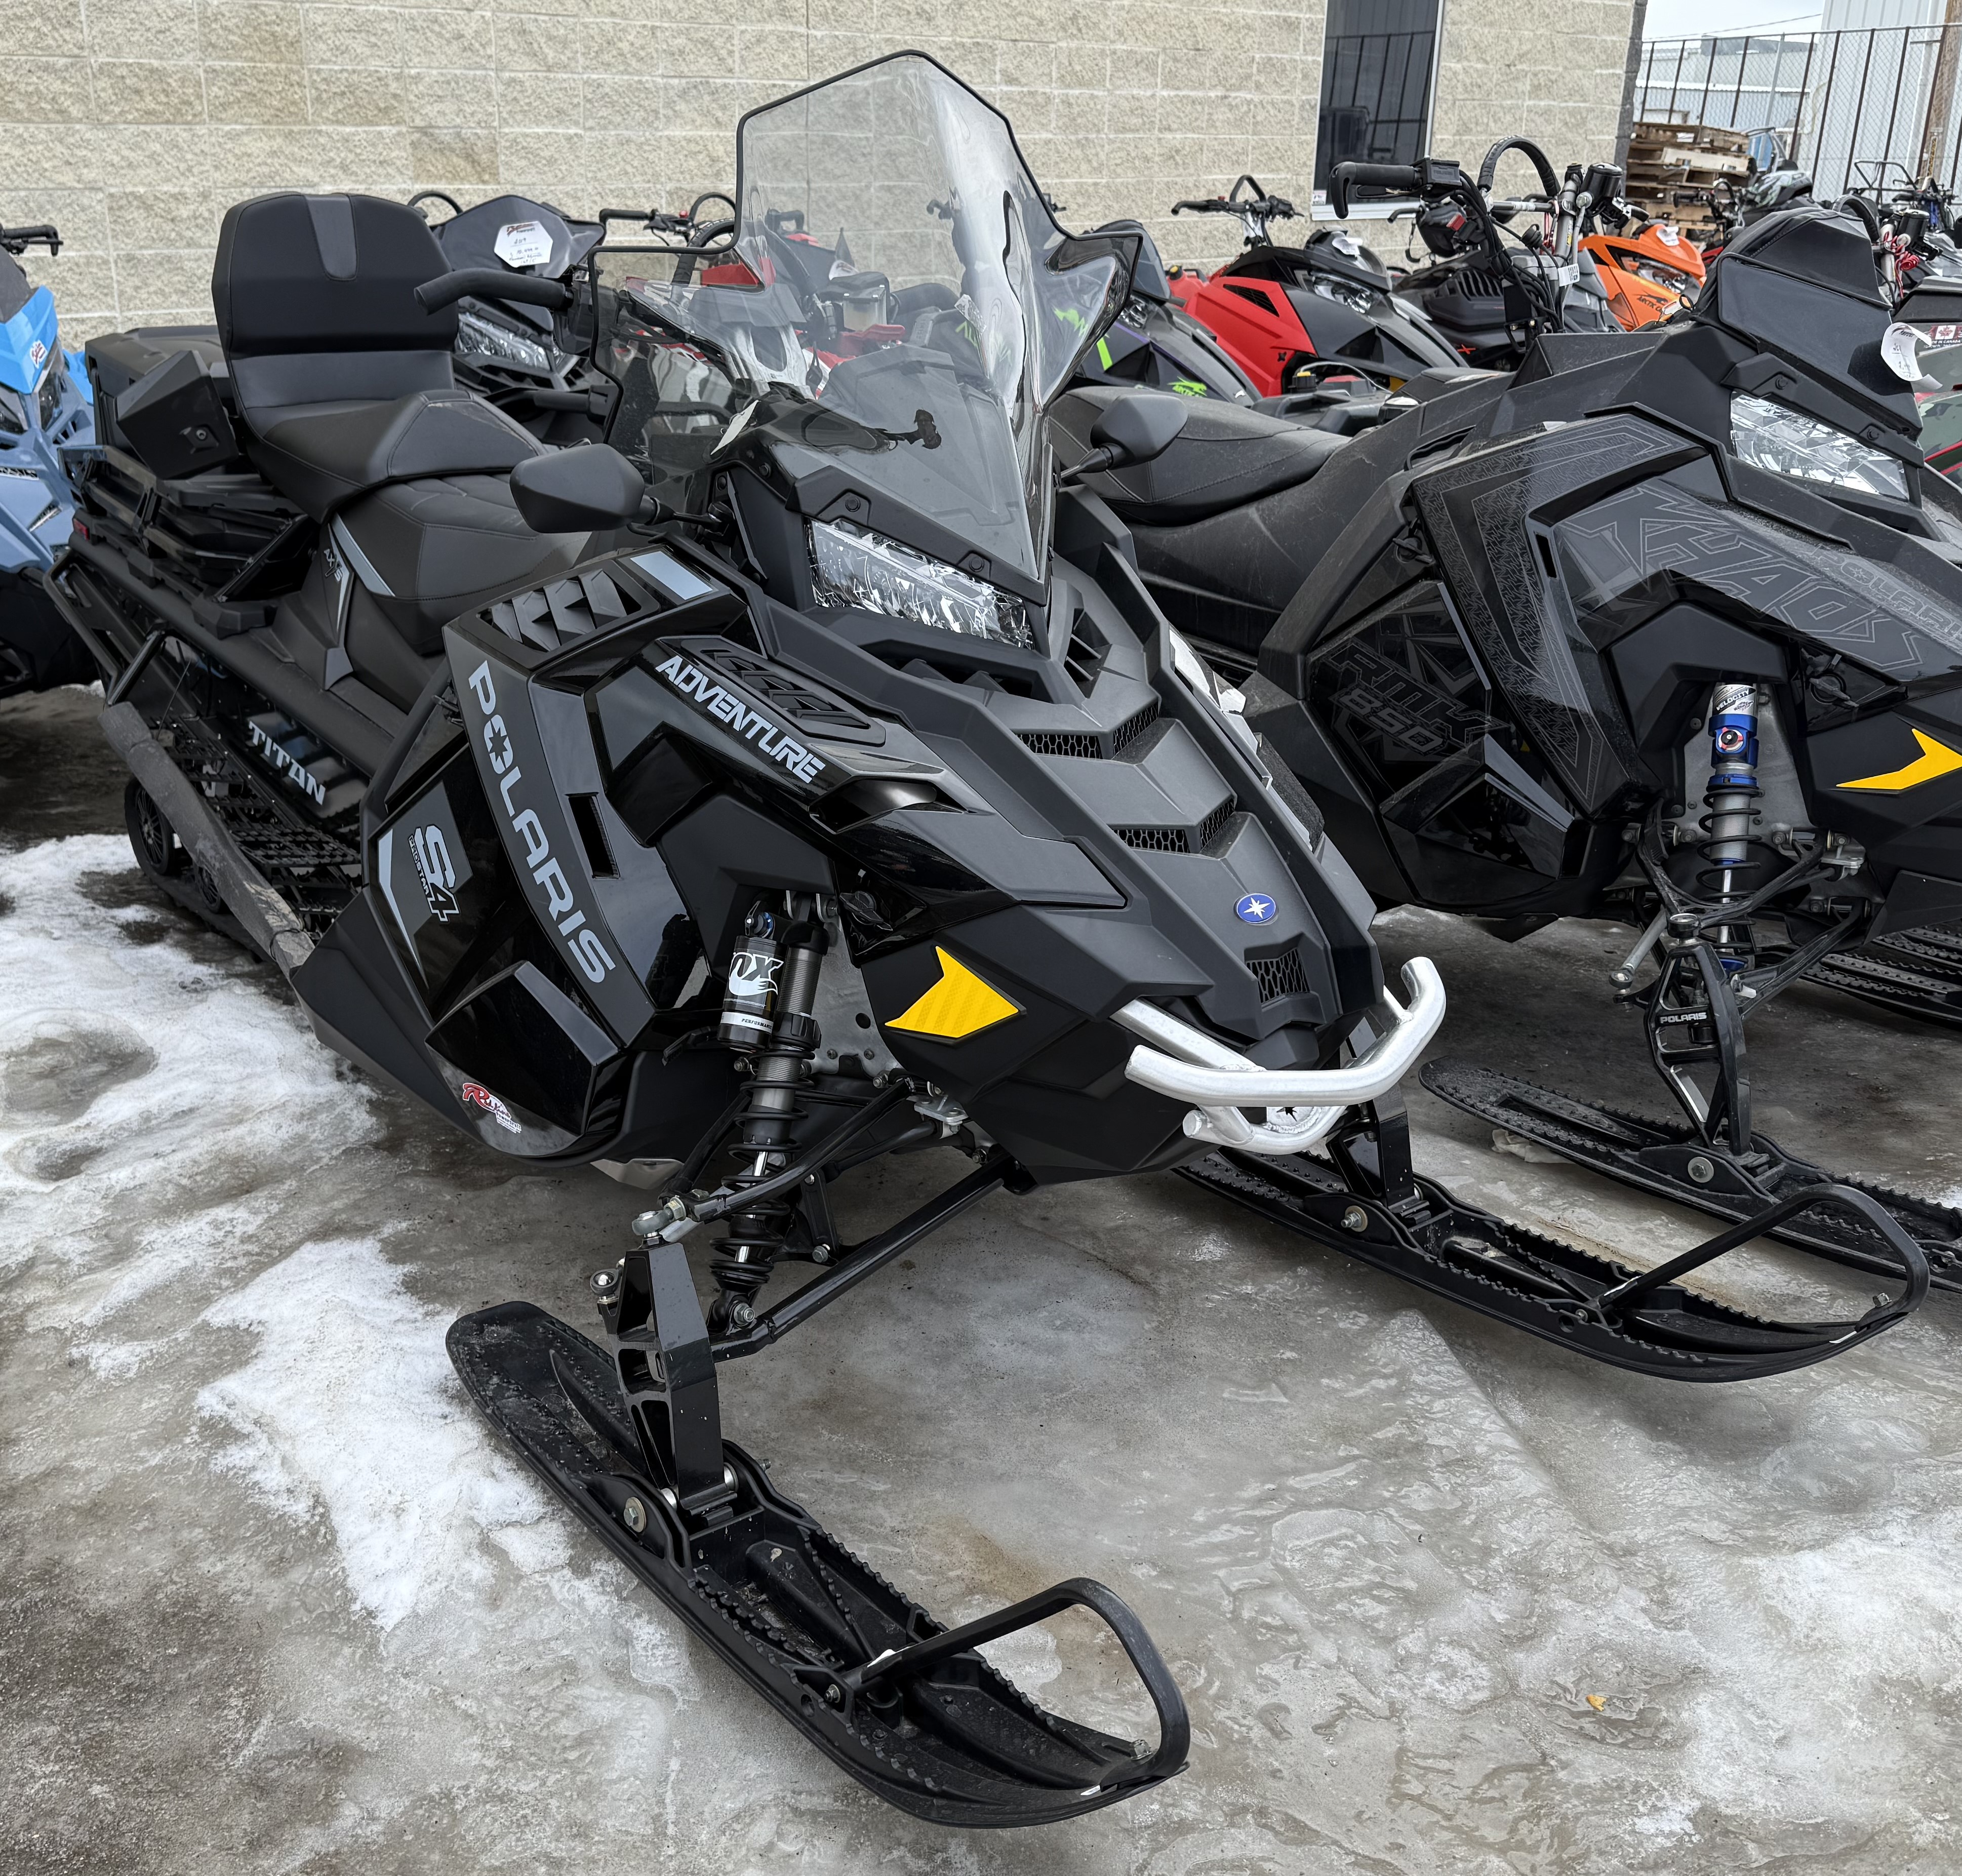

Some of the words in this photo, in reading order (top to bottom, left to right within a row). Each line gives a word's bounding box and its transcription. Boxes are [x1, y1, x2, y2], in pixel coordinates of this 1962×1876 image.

[1560, 485, 1925, 671] KHAOS
[1810, 543, 1962, 640] POLARI
[655, 655, 826, 784] ADVENTURE
[1328, 642, 1494, 748] RMK
[1337, 687, 1444, 753] 850
[1716, 688, 1749, 711] VELOCITY
[249, 721, 326, 806] TITAN
[408, 835, 430, 896] PROSTAR
[468, 660, 616, 983] POLARIS
[414, 824, 460, 923] S4
[729, 951, 784, 985] OX
[1660, 1012, 1707, 1024] POLARIS
